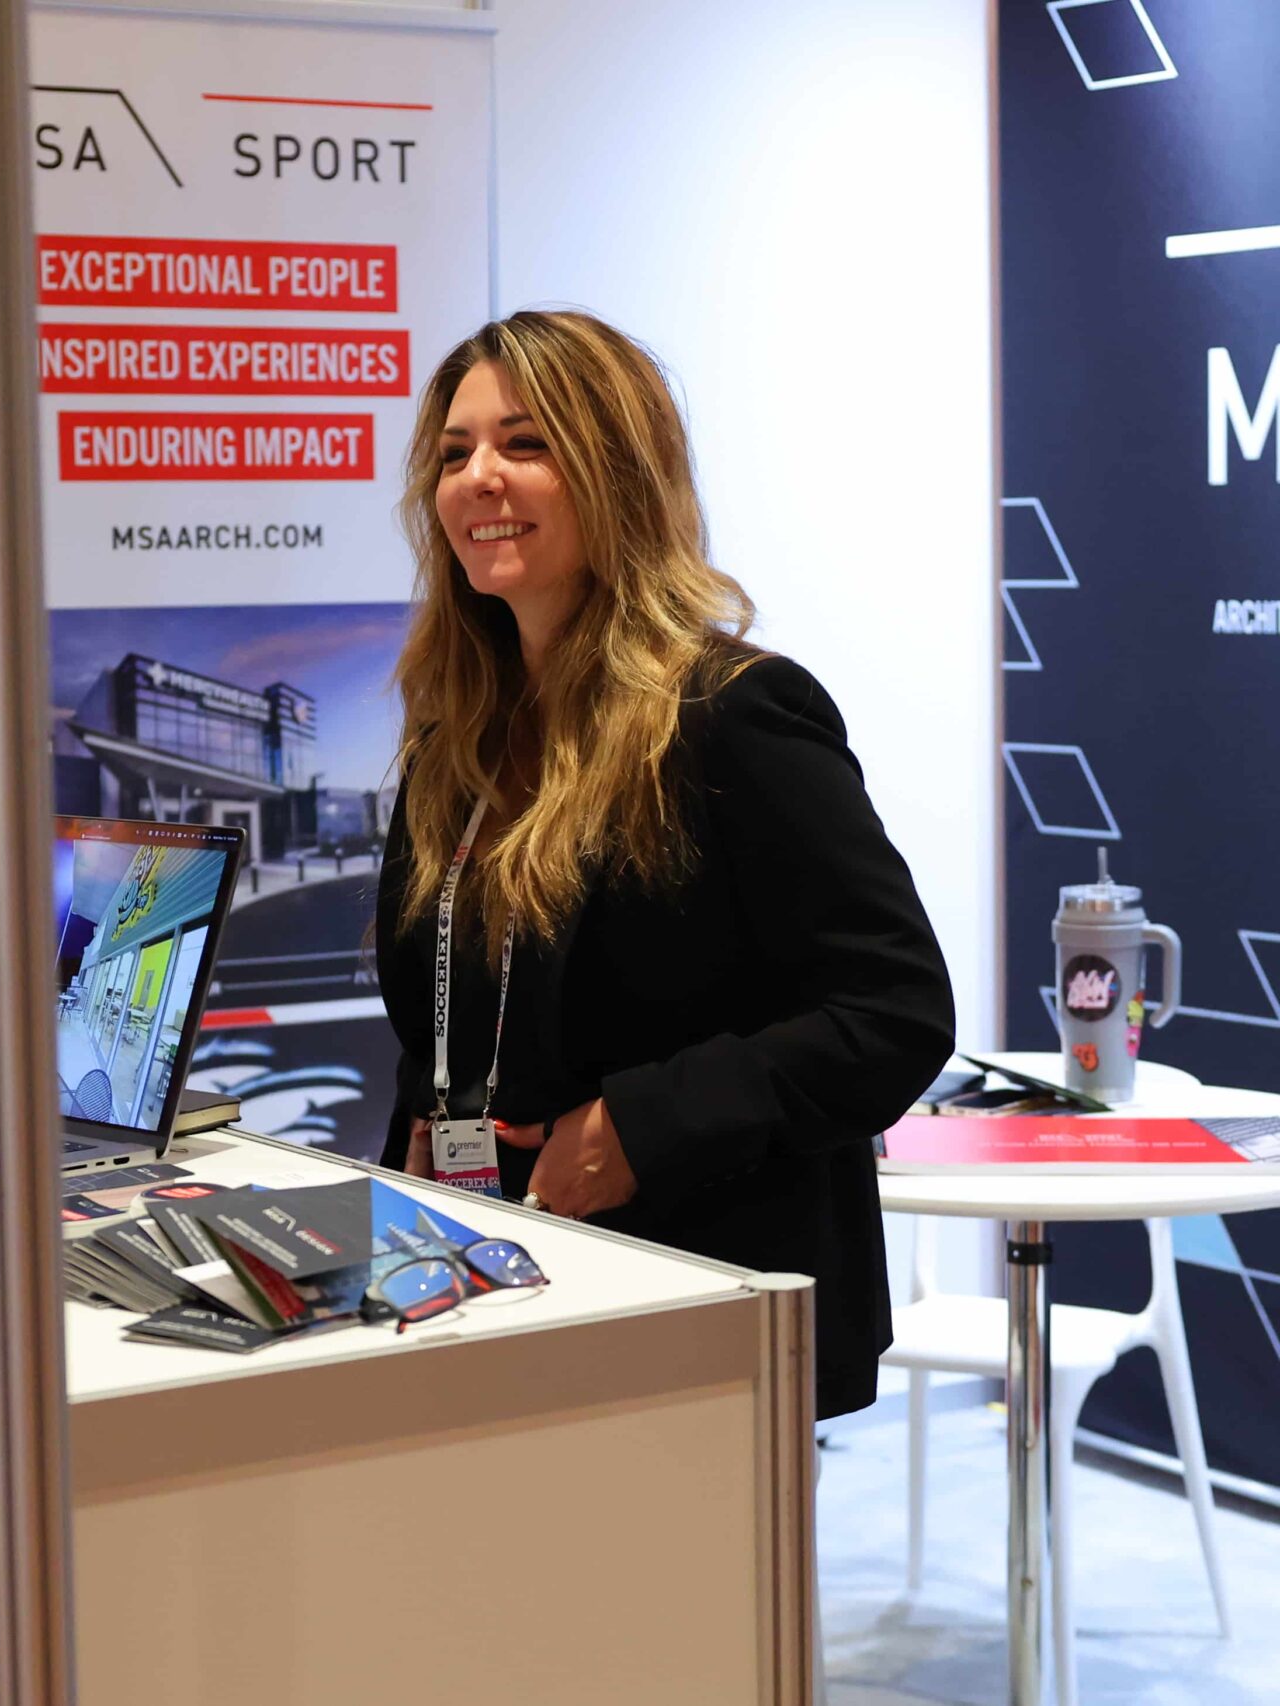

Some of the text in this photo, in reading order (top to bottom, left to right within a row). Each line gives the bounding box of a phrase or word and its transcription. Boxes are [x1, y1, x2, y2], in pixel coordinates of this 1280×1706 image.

[35, 124, 417, 184] SA SPORT
[39, 249, 386, 300] EXCEPTIONAL PEOPLE
[188, 340, 400, 384] EXPERIENCES
[72, 425, 363, 468] ENDURING IMPACT
[111, 523, 324, 551] MSAARCH.COM
[435, 931, 449, 1037] SOCCEREX
